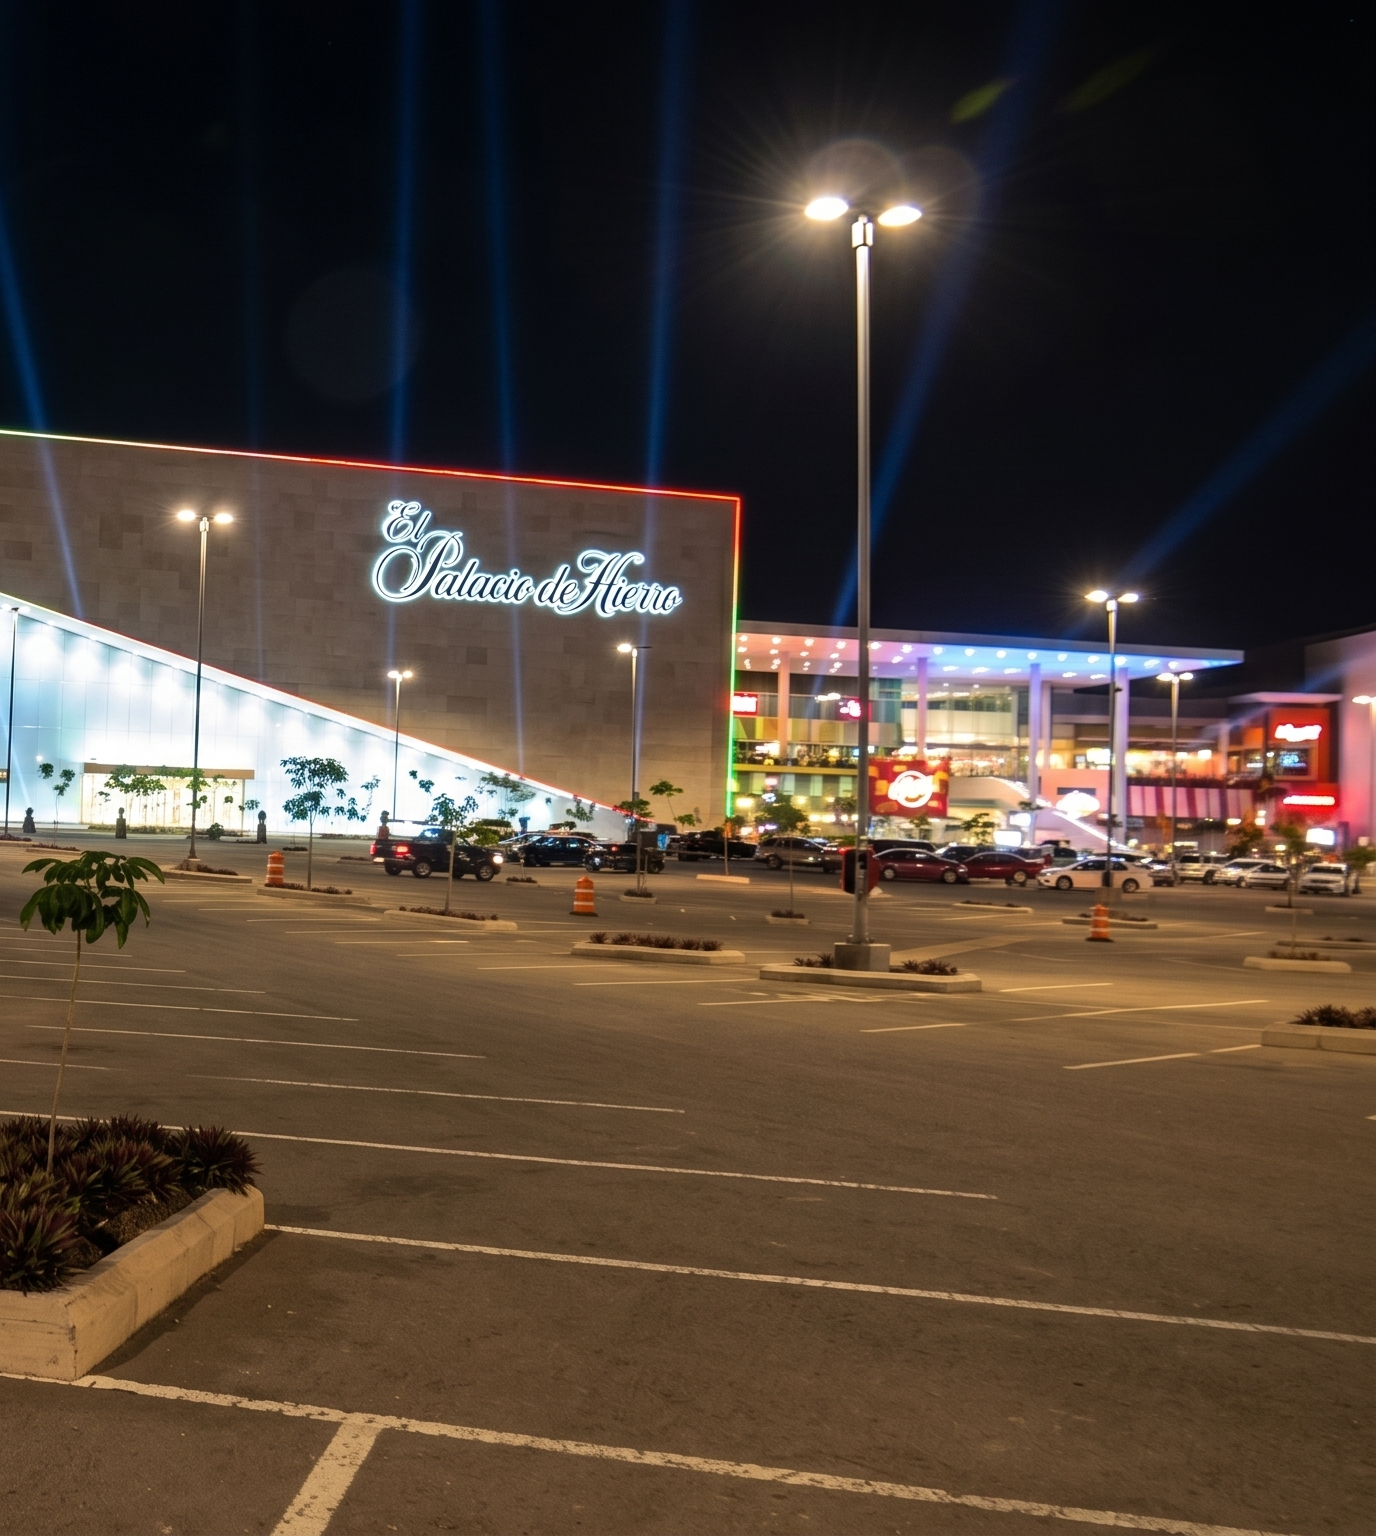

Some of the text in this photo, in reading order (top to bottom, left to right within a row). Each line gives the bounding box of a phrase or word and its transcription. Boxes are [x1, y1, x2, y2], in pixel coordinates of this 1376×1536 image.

[382, 500, 431, 543] El
[373, 530, 683, 617] Palacio de Hierro
